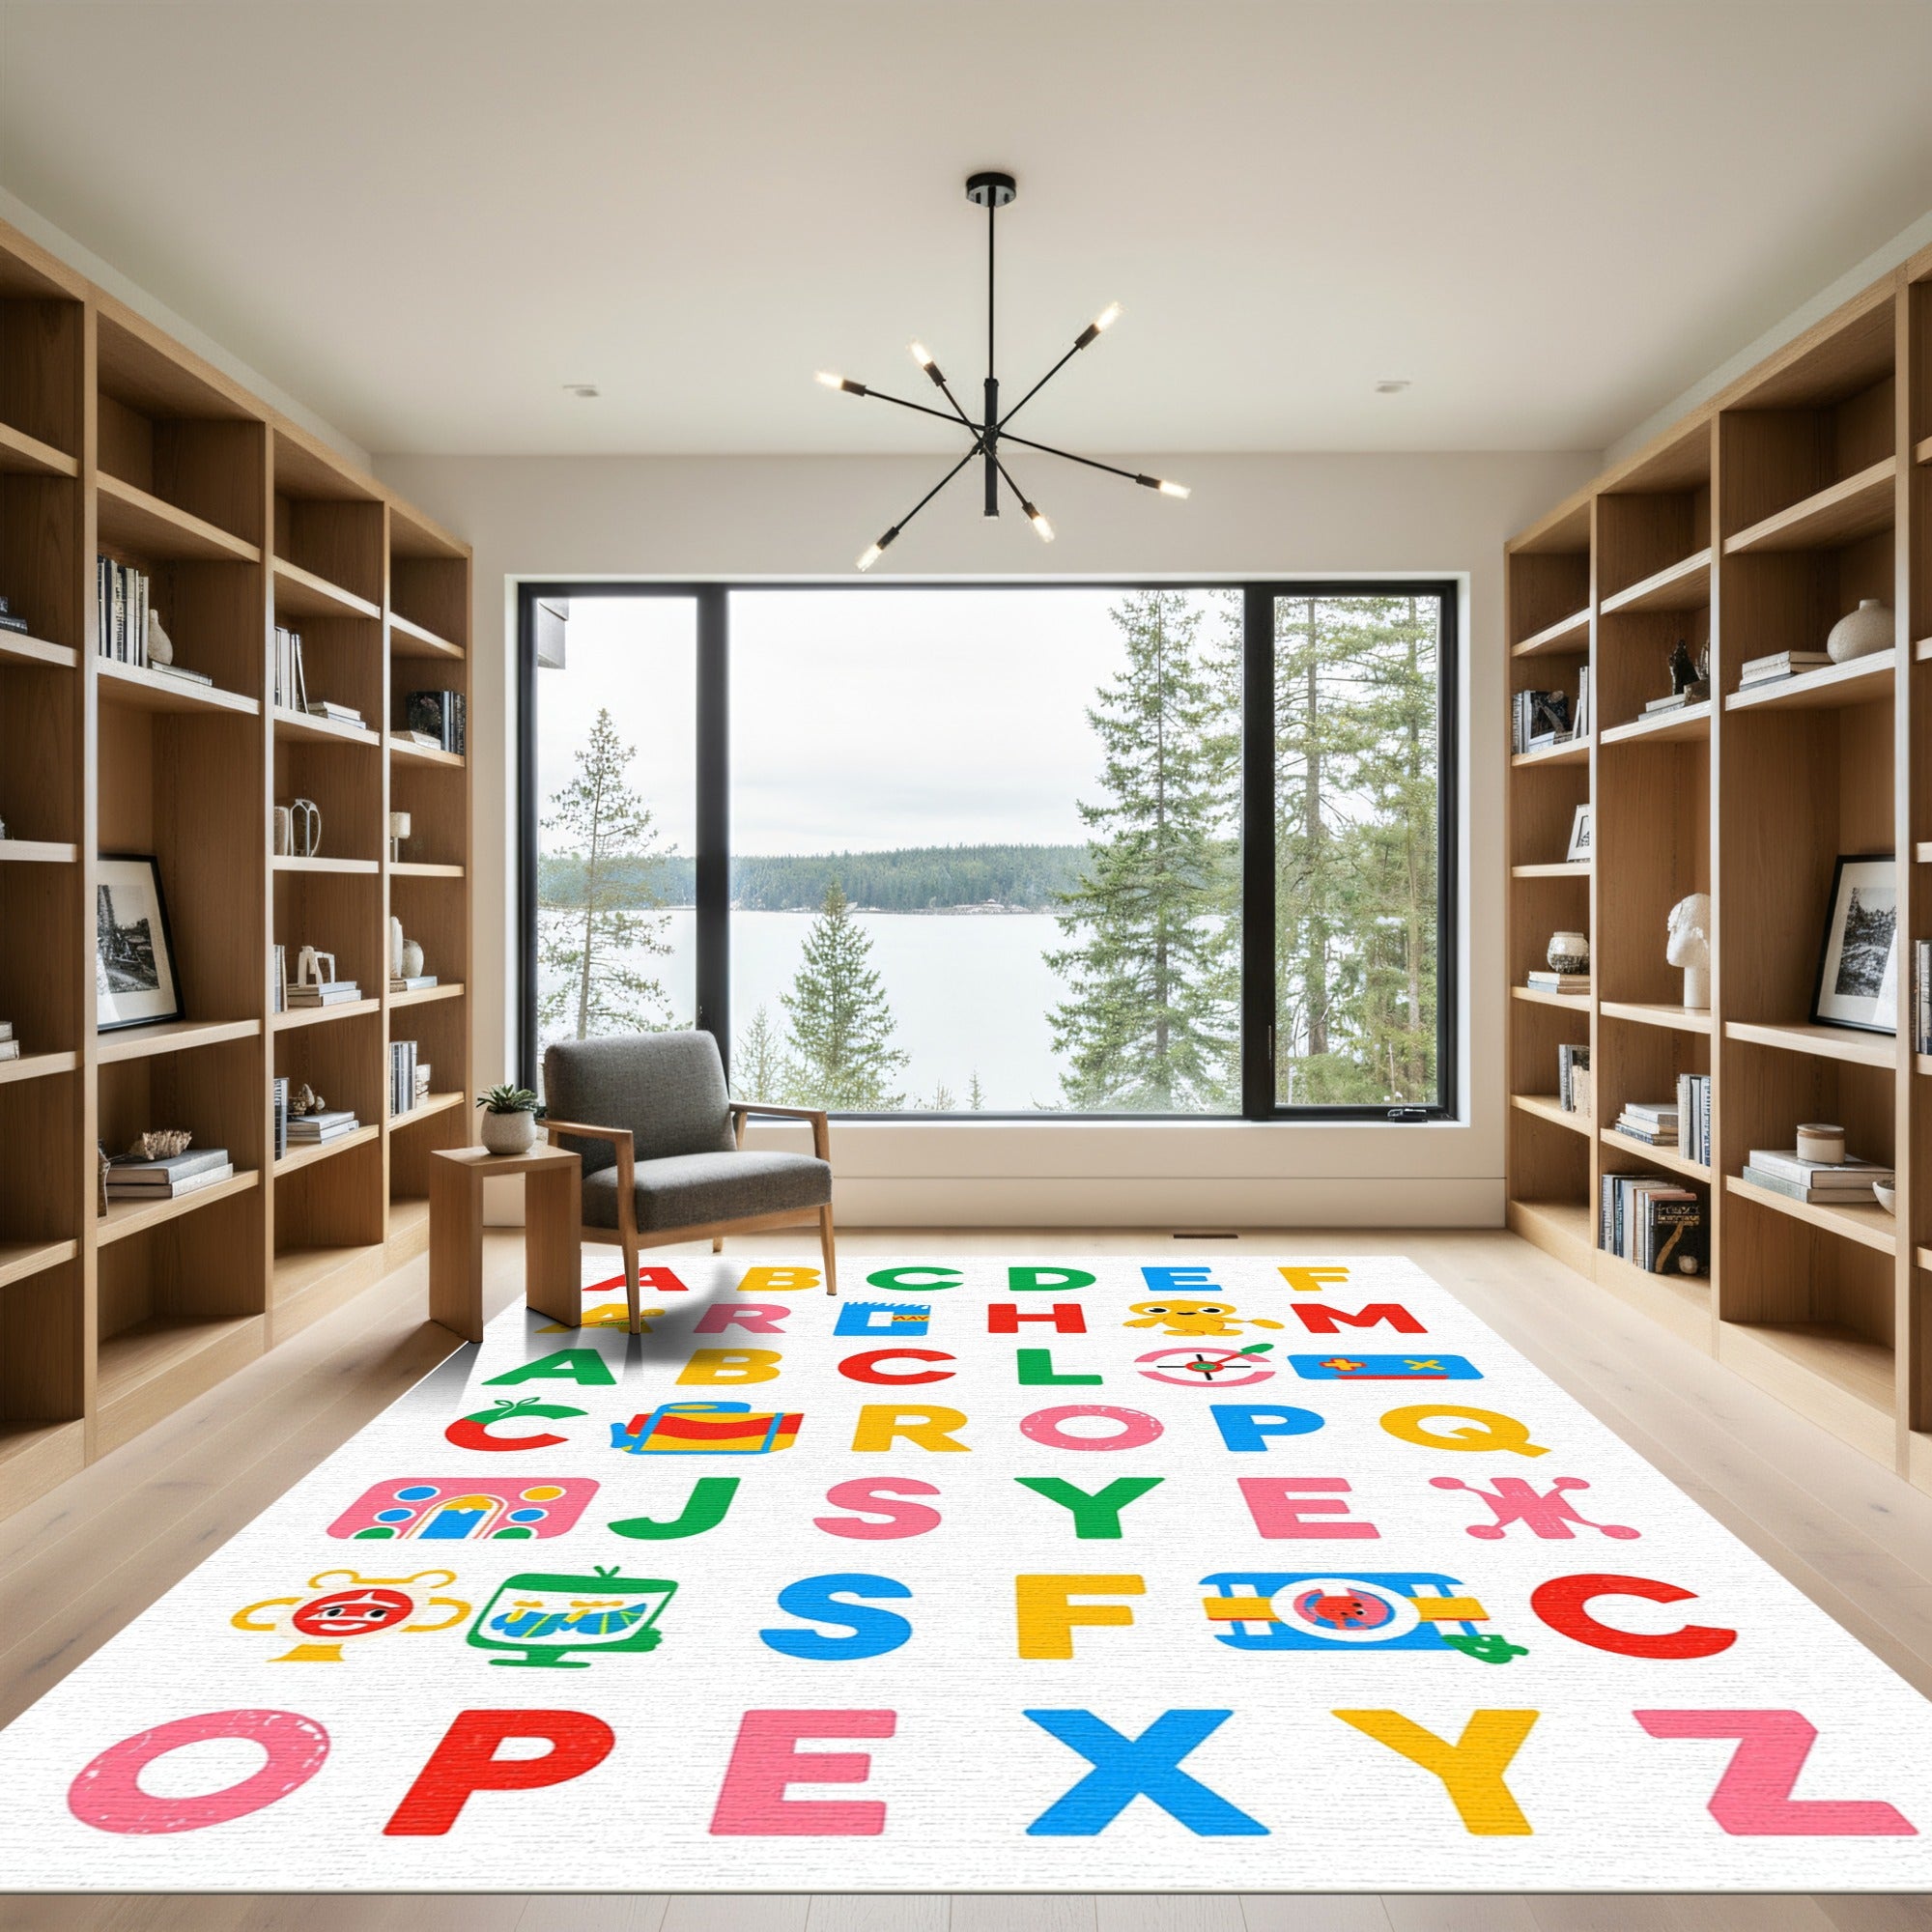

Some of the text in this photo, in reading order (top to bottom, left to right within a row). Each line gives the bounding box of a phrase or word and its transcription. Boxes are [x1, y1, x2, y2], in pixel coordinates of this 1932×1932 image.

[582, 1266, 1350, 1292] A B C D E F
[694, 1303, 792, 1334] R
[988, 1303, 1087, 1334] H
[1291, 1303, 1428, 1334] M
[482, 1349, 1103, 1385] A B C L
[851, 1405, 971, 1452] R
[1019, 1405, 1165, 1452] O
[1209, 1405, 1325, 1452] P
[1379, 1405, 1551, 1458] Q
[608, 1477, 1381, 1540] J S Y E
[758, 1573, 1738, 1661] S F C
[68, 1709, 1918, 1836] O P E X Y Z
